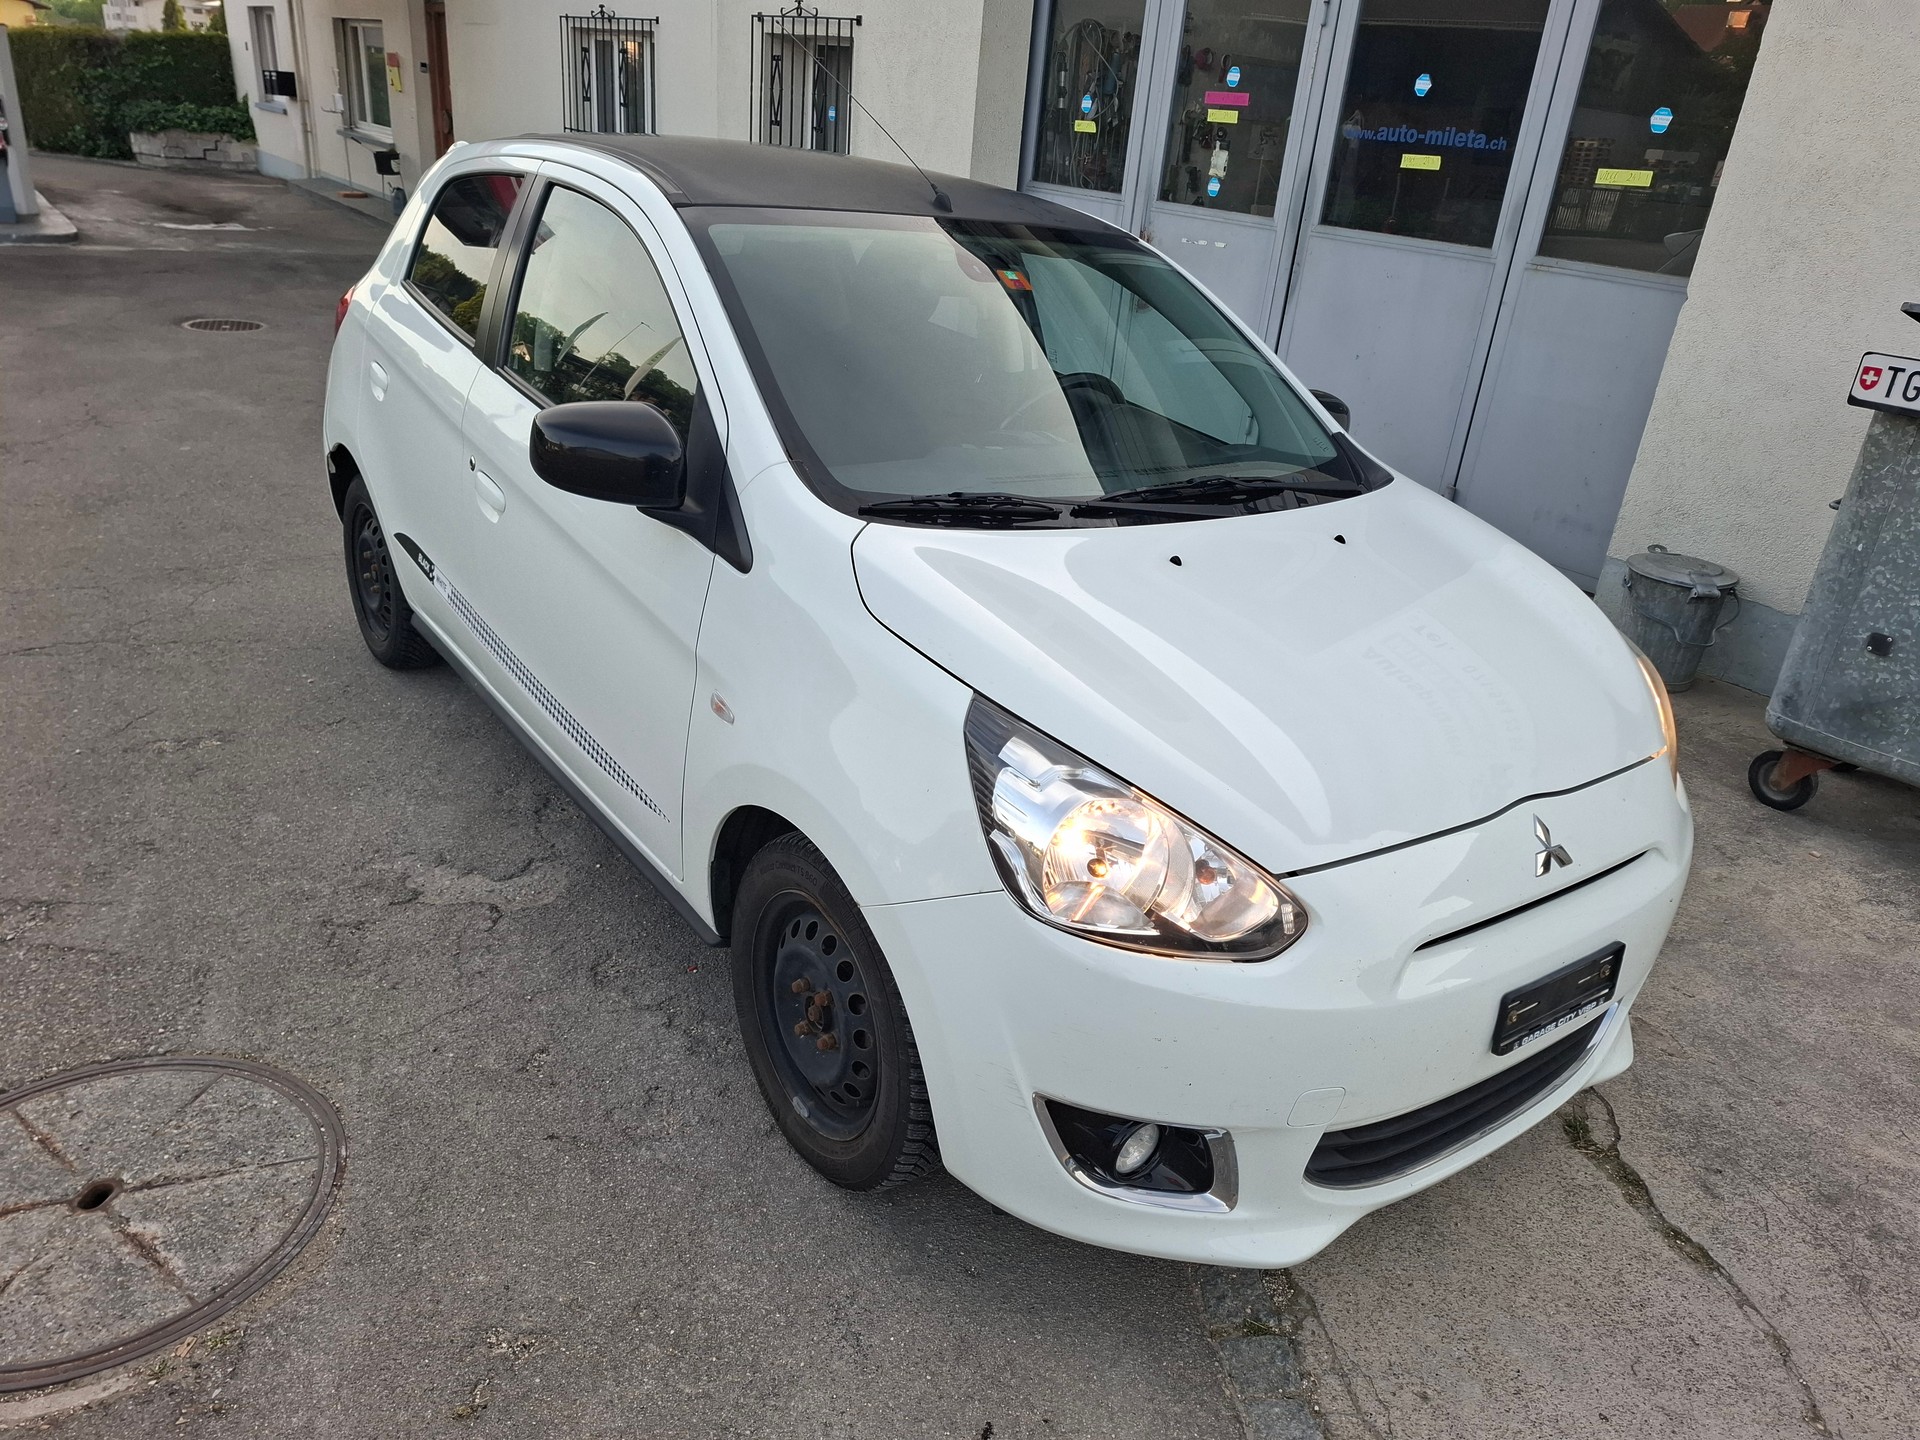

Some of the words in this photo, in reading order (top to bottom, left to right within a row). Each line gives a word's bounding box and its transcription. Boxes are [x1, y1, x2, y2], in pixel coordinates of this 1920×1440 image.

[1885, 365, 1920, 402] TG
[1521, 1021, 1557, 1046] GARAGE
[1557, 1011, 1578, 1028] CITY
